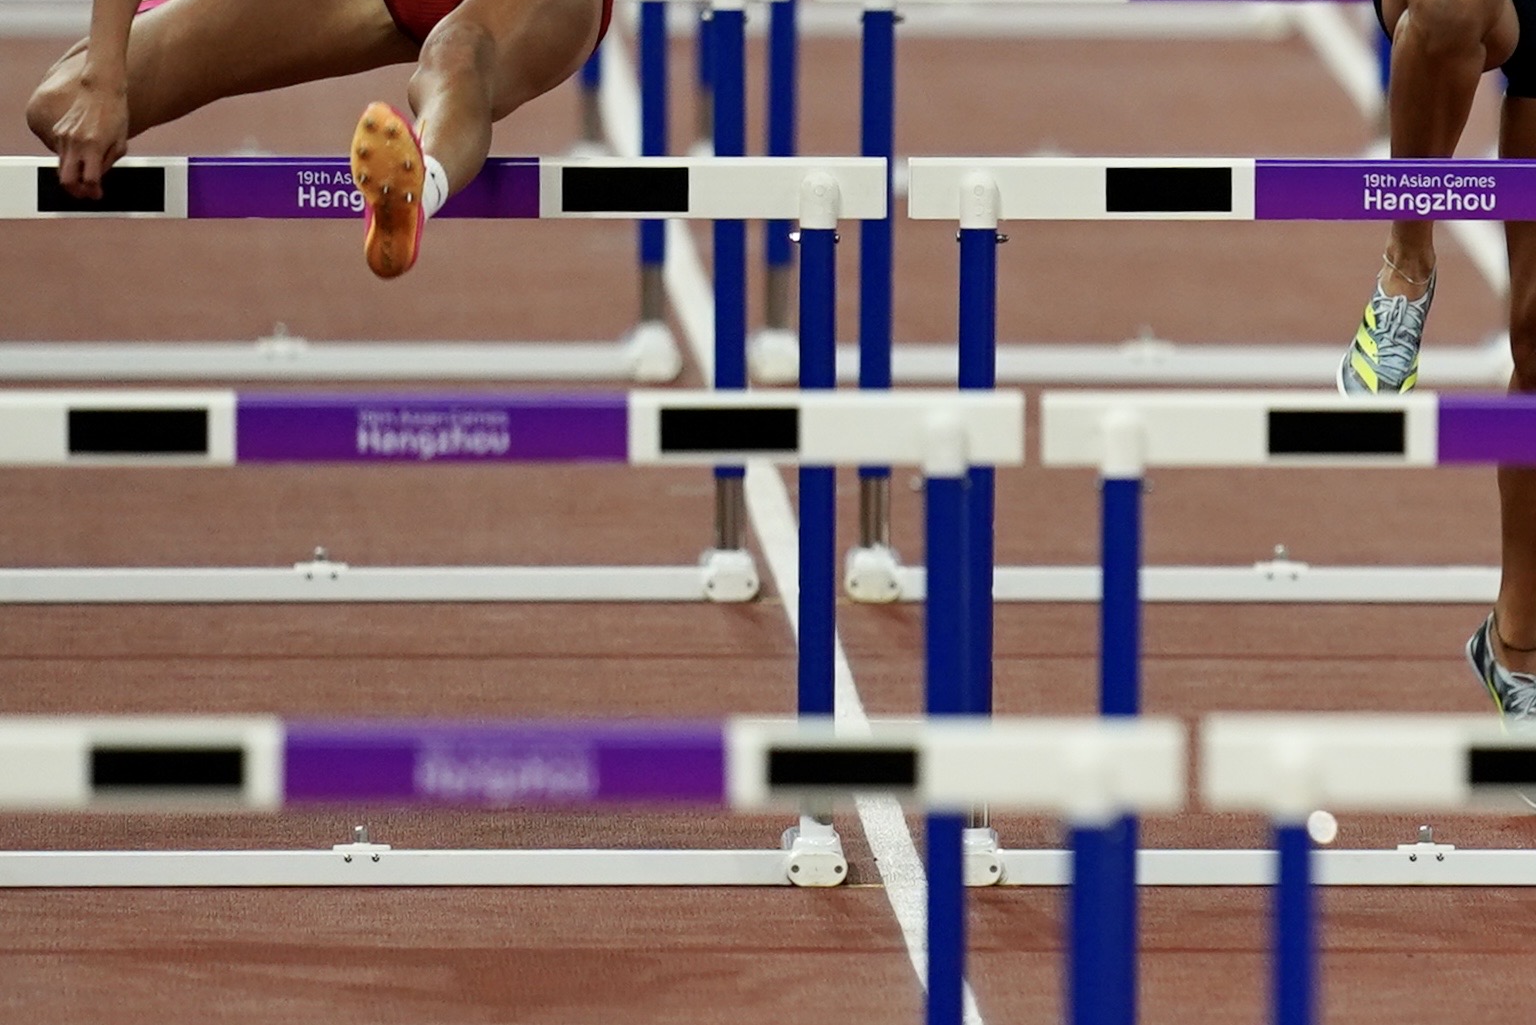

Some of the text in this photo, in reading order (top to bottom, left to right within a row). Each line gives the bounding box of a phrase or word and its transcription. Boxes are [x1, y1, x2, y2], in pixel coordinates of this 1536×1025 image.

[297, 171, 330, 185] 19th
[1363, 173, 1496, 188] 19th Asian Games
[298, 186, 366, 213] Hang
[1364, 188, 1496, 215] Hangzhou
